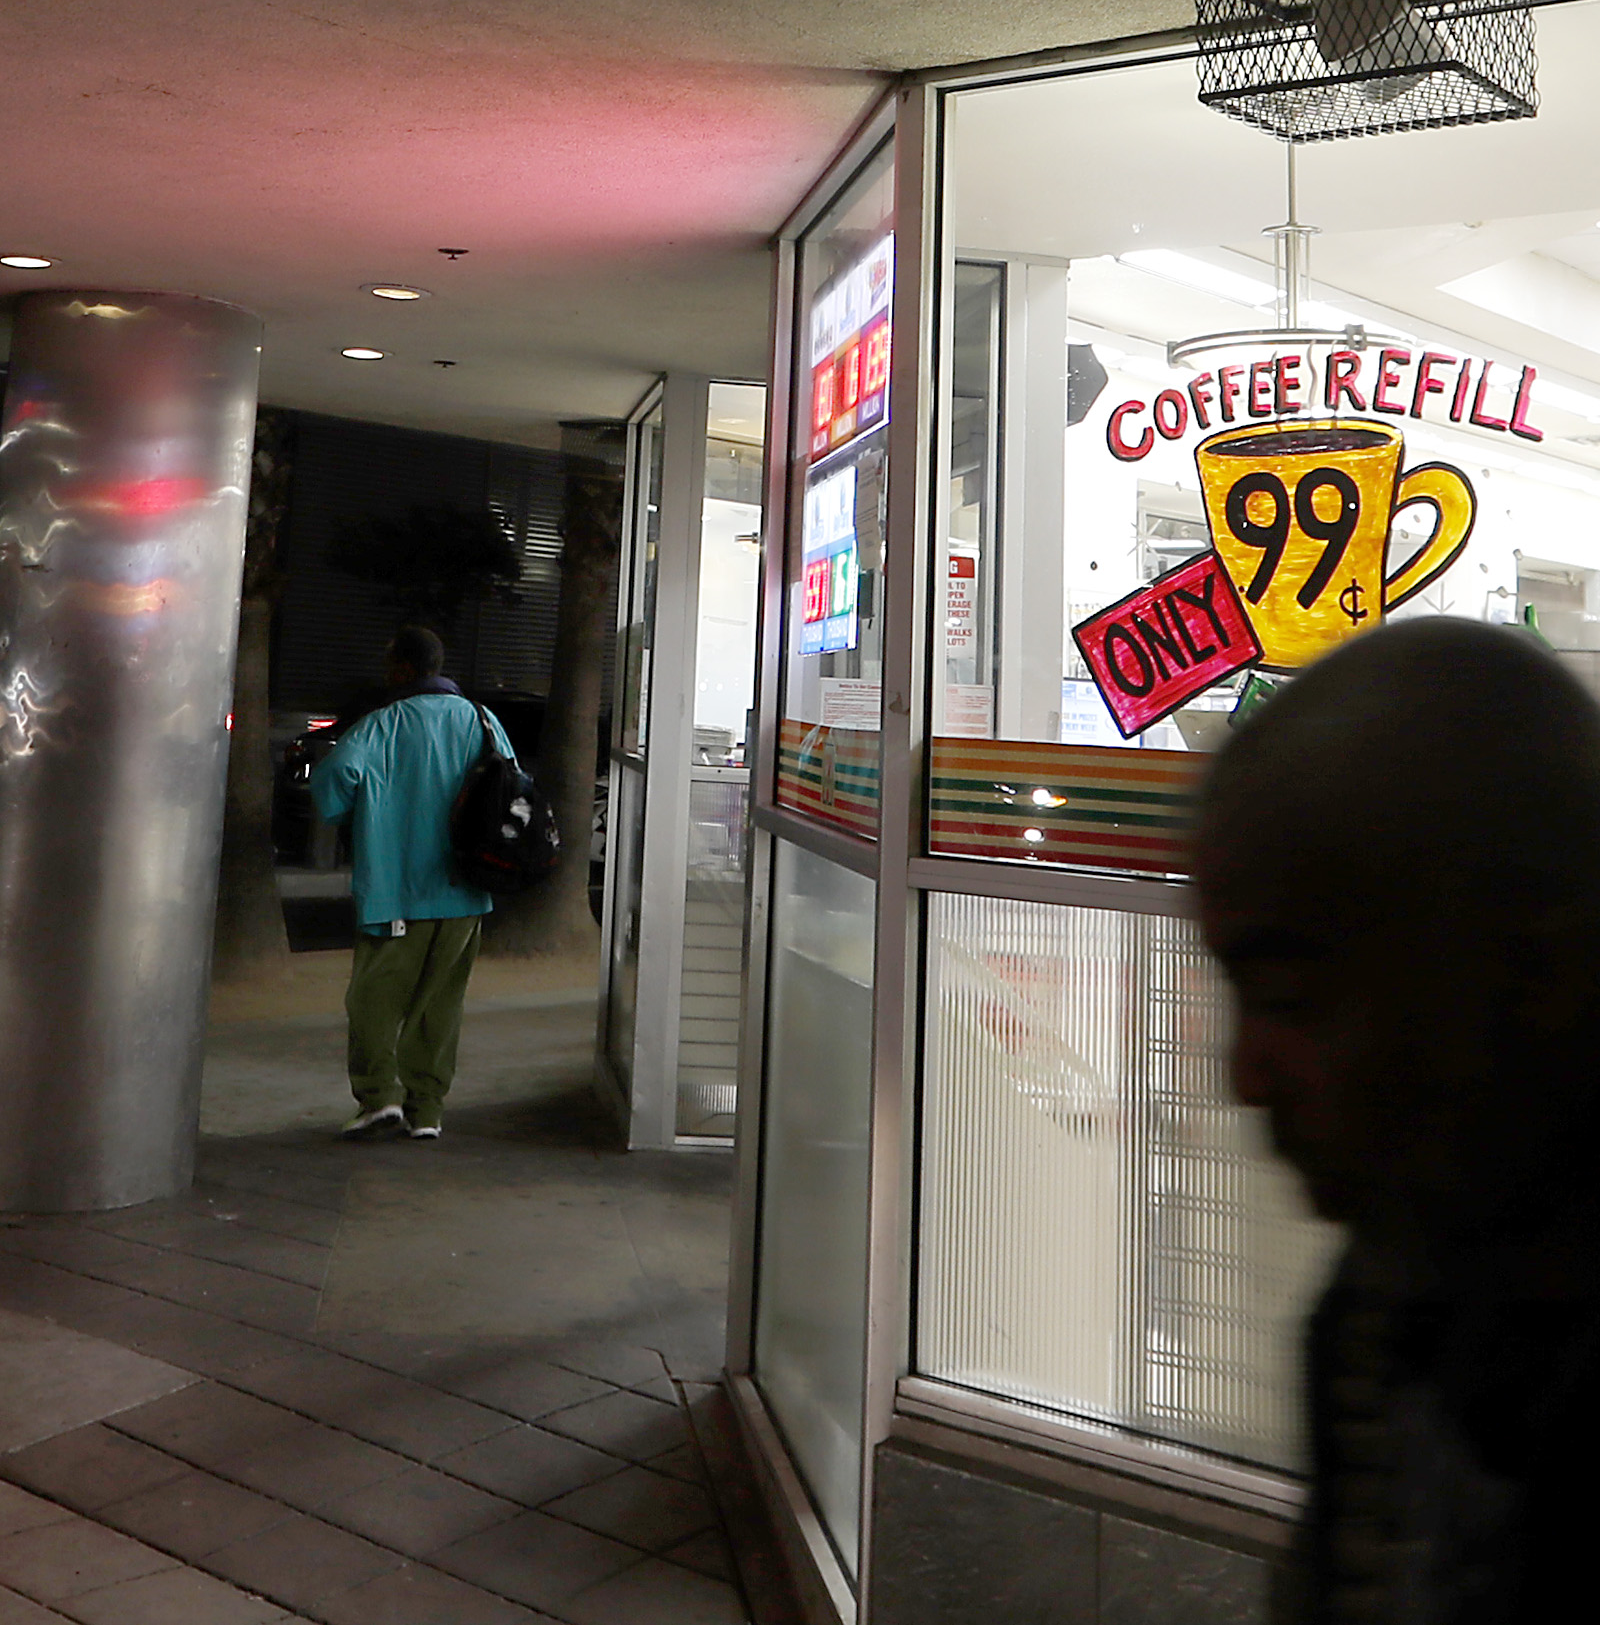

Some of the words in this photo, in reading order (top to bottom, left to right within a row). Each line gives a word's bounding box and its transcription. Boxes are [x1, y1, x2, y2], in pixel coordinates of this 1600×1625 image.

[1106, 354, 1303, 463] COFFEE
[1323, 348, 1545, 443] REFILL
[956, 581, 967, 590] TO
[1102, 576, 1233, 700] ONLY
